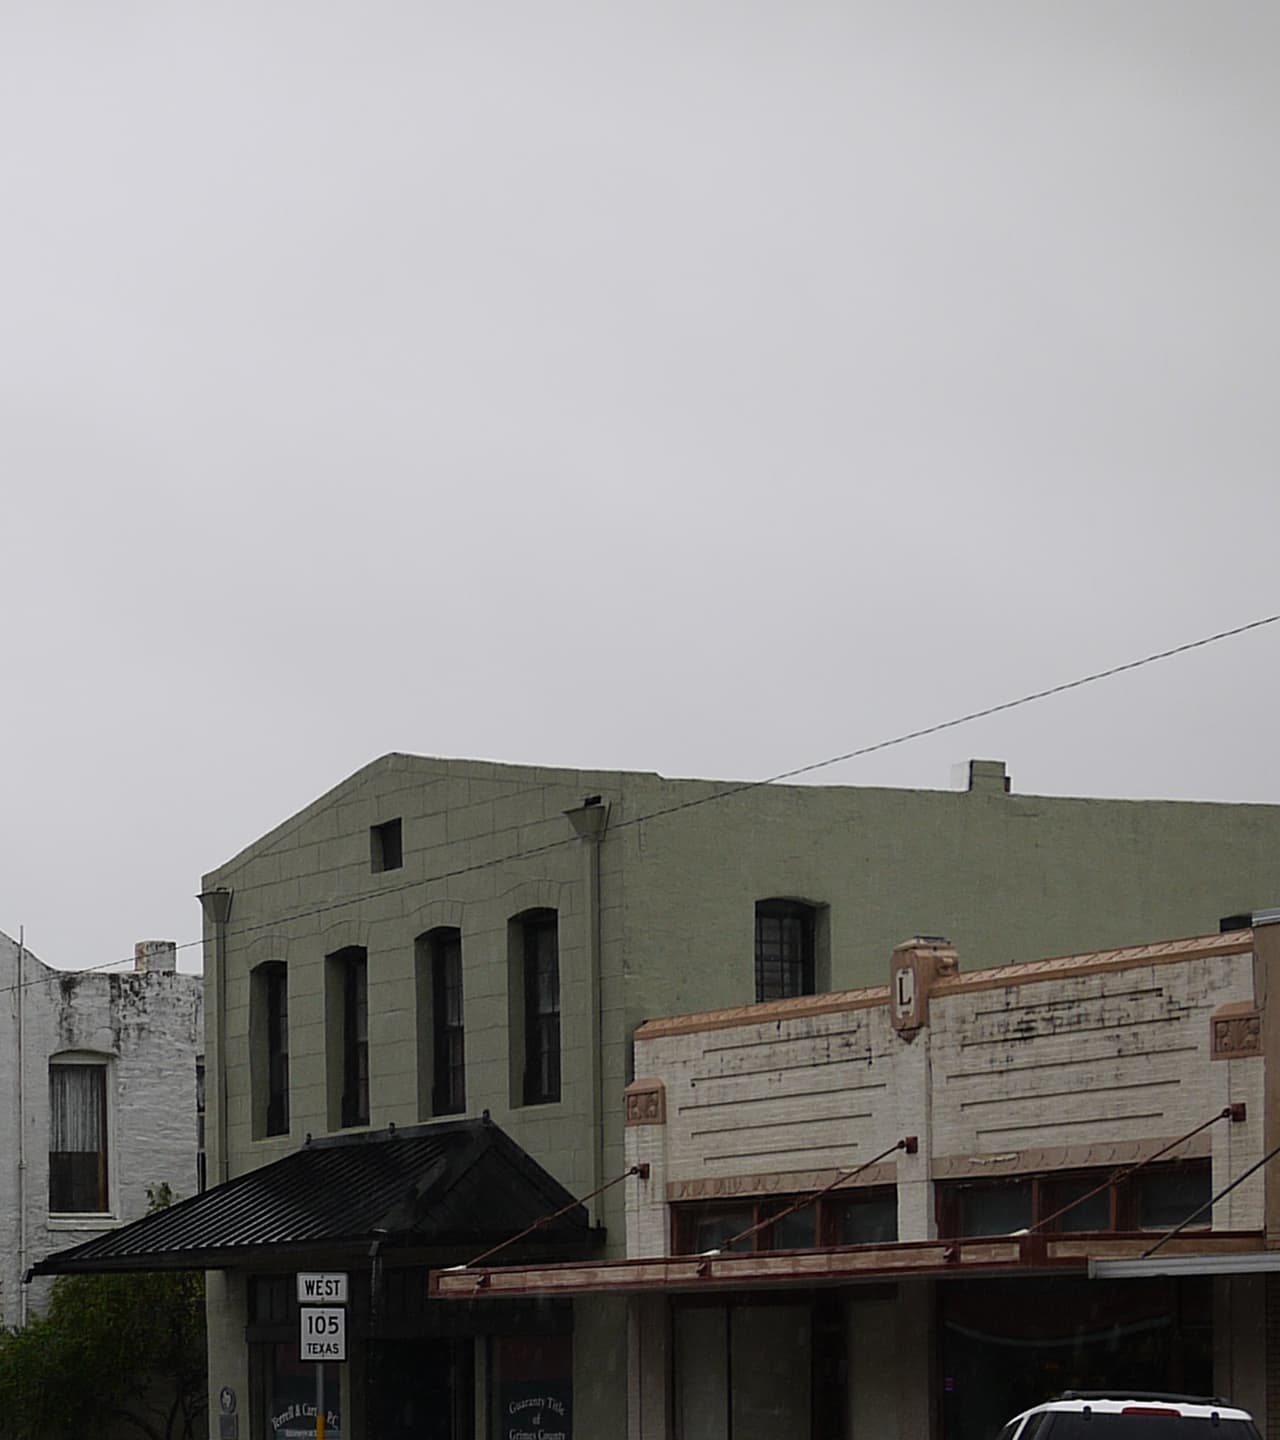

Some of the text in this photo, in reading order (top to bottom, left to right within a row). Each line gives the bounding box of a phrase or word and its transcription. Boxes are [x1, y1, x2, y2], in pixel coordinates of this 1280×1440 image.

[898, 976, 914, 1007] L
[304, 1279, 341, 1296] WEST
[307, 1315, 340, 1335] 105
[306, 1343, 340, 1355] TEXAS
[508, 1396, 565, 1416] Guaranty Title
[508, 1428, 536, 1440] Grimes
